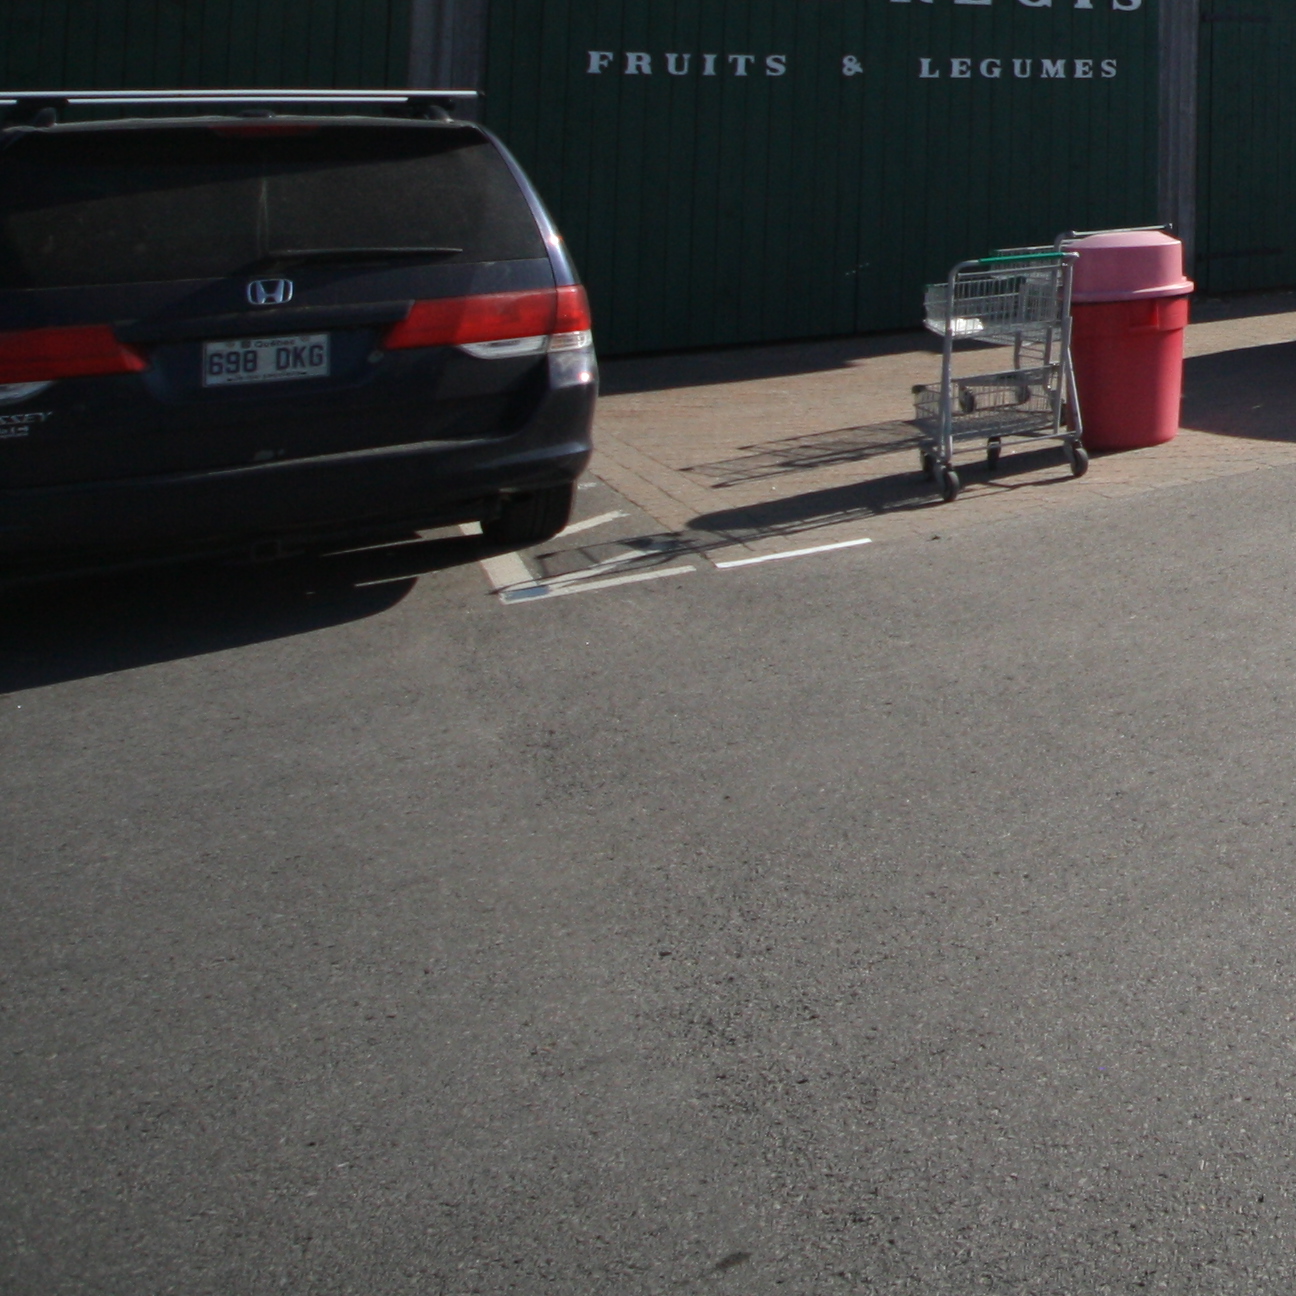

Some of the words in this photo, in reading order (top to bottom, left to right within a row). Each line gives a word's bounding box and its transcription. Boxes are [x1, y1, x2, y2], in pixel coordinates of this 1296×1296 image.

[586, 50, 788, 77] FRUITS
[842, 54, 864, 77] &
[919, 57, 1119, 80] LEGUMES
[209, 350, 258, 375] 698
[276, 344, 324, 371] DKG
